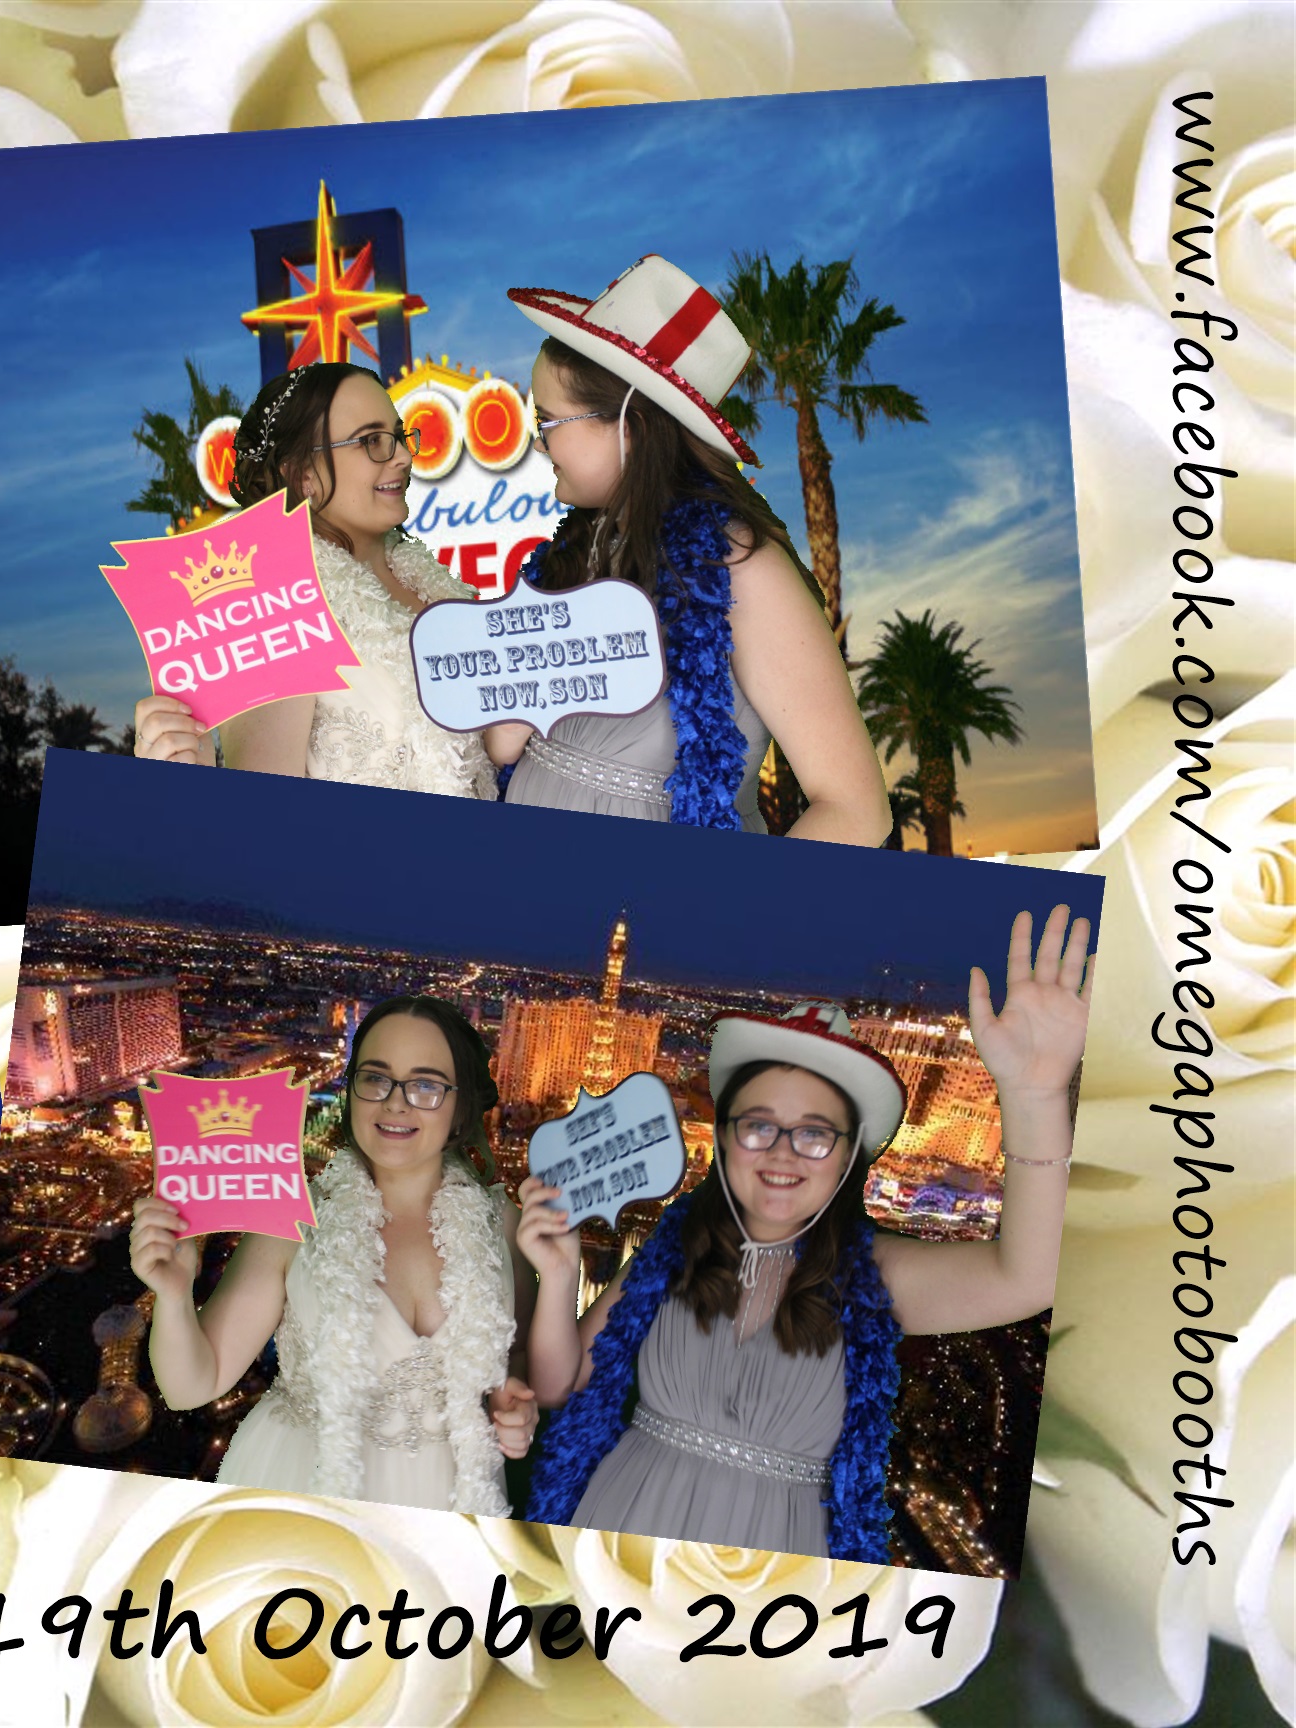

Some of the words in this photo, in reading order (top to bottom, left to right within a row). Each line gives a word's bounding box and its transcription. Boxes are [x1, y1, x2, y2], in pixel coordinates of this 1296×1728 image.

[143, 579, 319, 655] DANCING
[485, 600, 571, 638] SHE'S
[157, 611, 334, 694] QUEEN
[423, 649, 501, 681] YOUR
[504, 629, 650, 673] PROBLEM
[477, 680, 547, 712] NOW,
[549, 672, 609, 705] SON
[156, 1142, 299, 1167] DANCING
[579, 1113, 672, 1175] PROBLEM
[158, 1173, 302, 1205] QUEEN
[608, 1159, 650, 1197] SON
